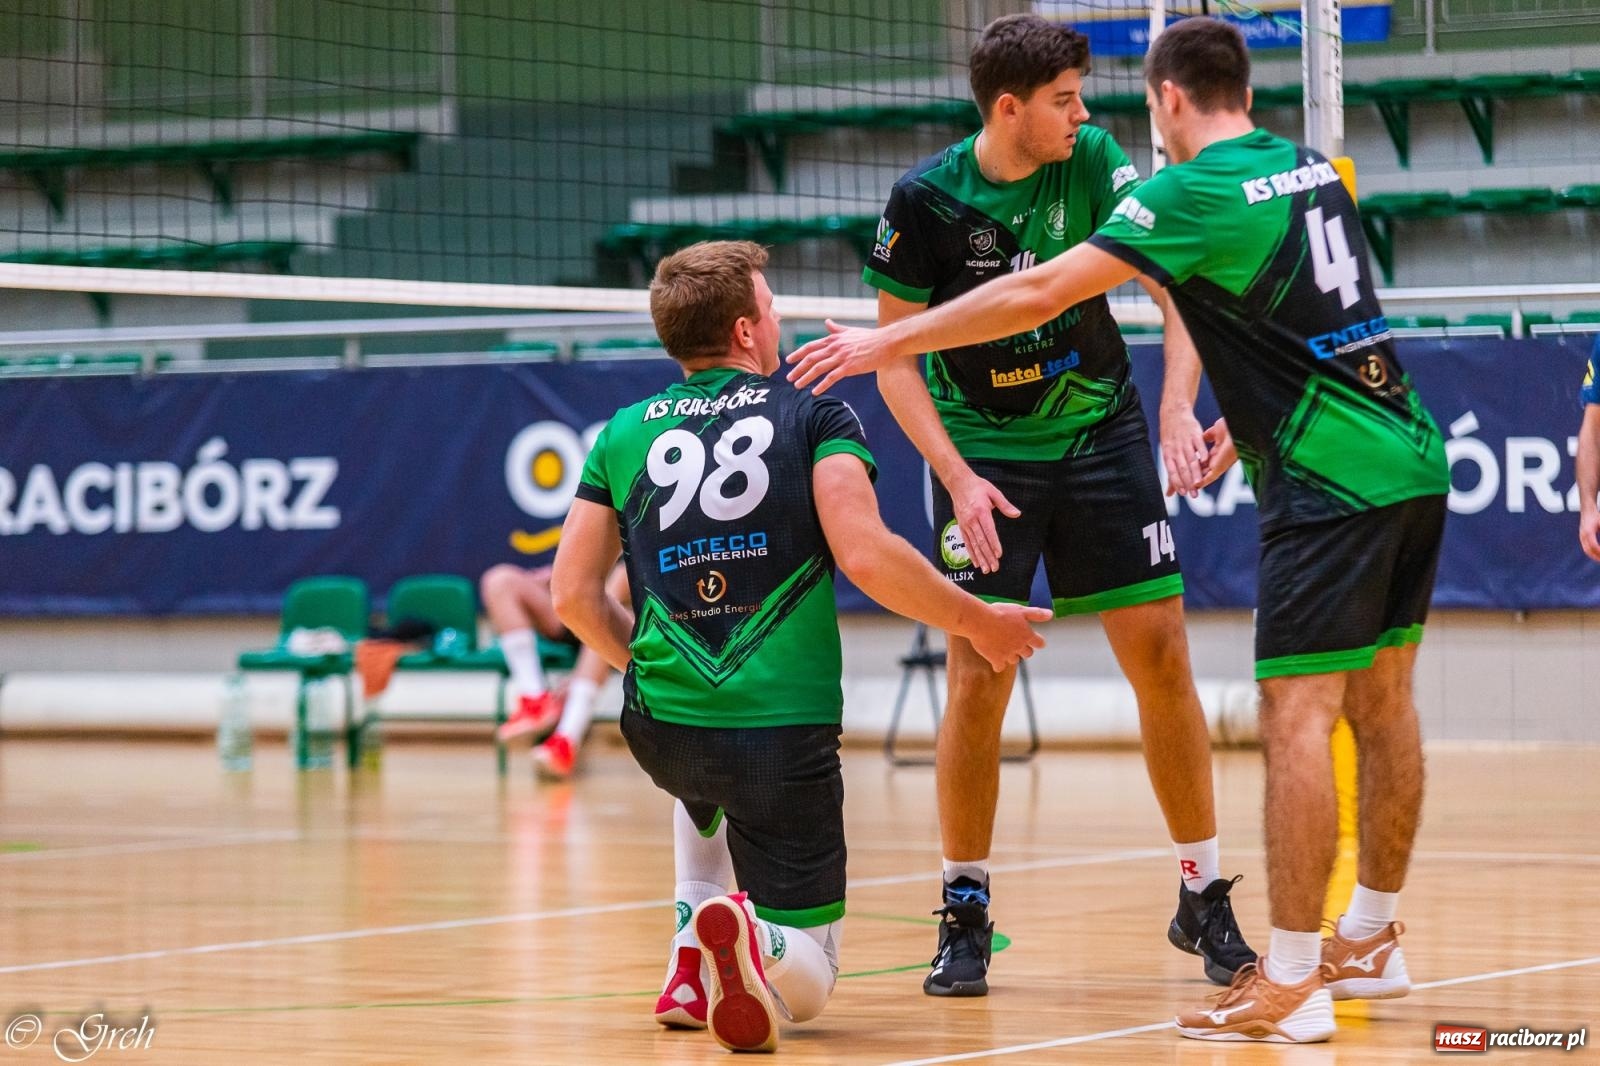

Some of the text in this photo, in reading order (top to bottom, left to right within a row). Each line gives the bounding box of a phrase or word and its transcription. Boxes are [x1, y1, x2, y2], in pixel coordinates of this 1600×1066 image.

[1241, 176, 1274, 206] KS
[874, 243, 891, 258] PCS
[1305, 206, 1361, 310] 4
[1014, 337, 1056, 355] KIETRZ
[643, 399, 673, 422] KS
[646, 415, 774, 532] 98
[658, 532, 768, 574] ENTECO
[1142, 519, 1175, 567] 14
[691, 607, 721, 619] Studio
